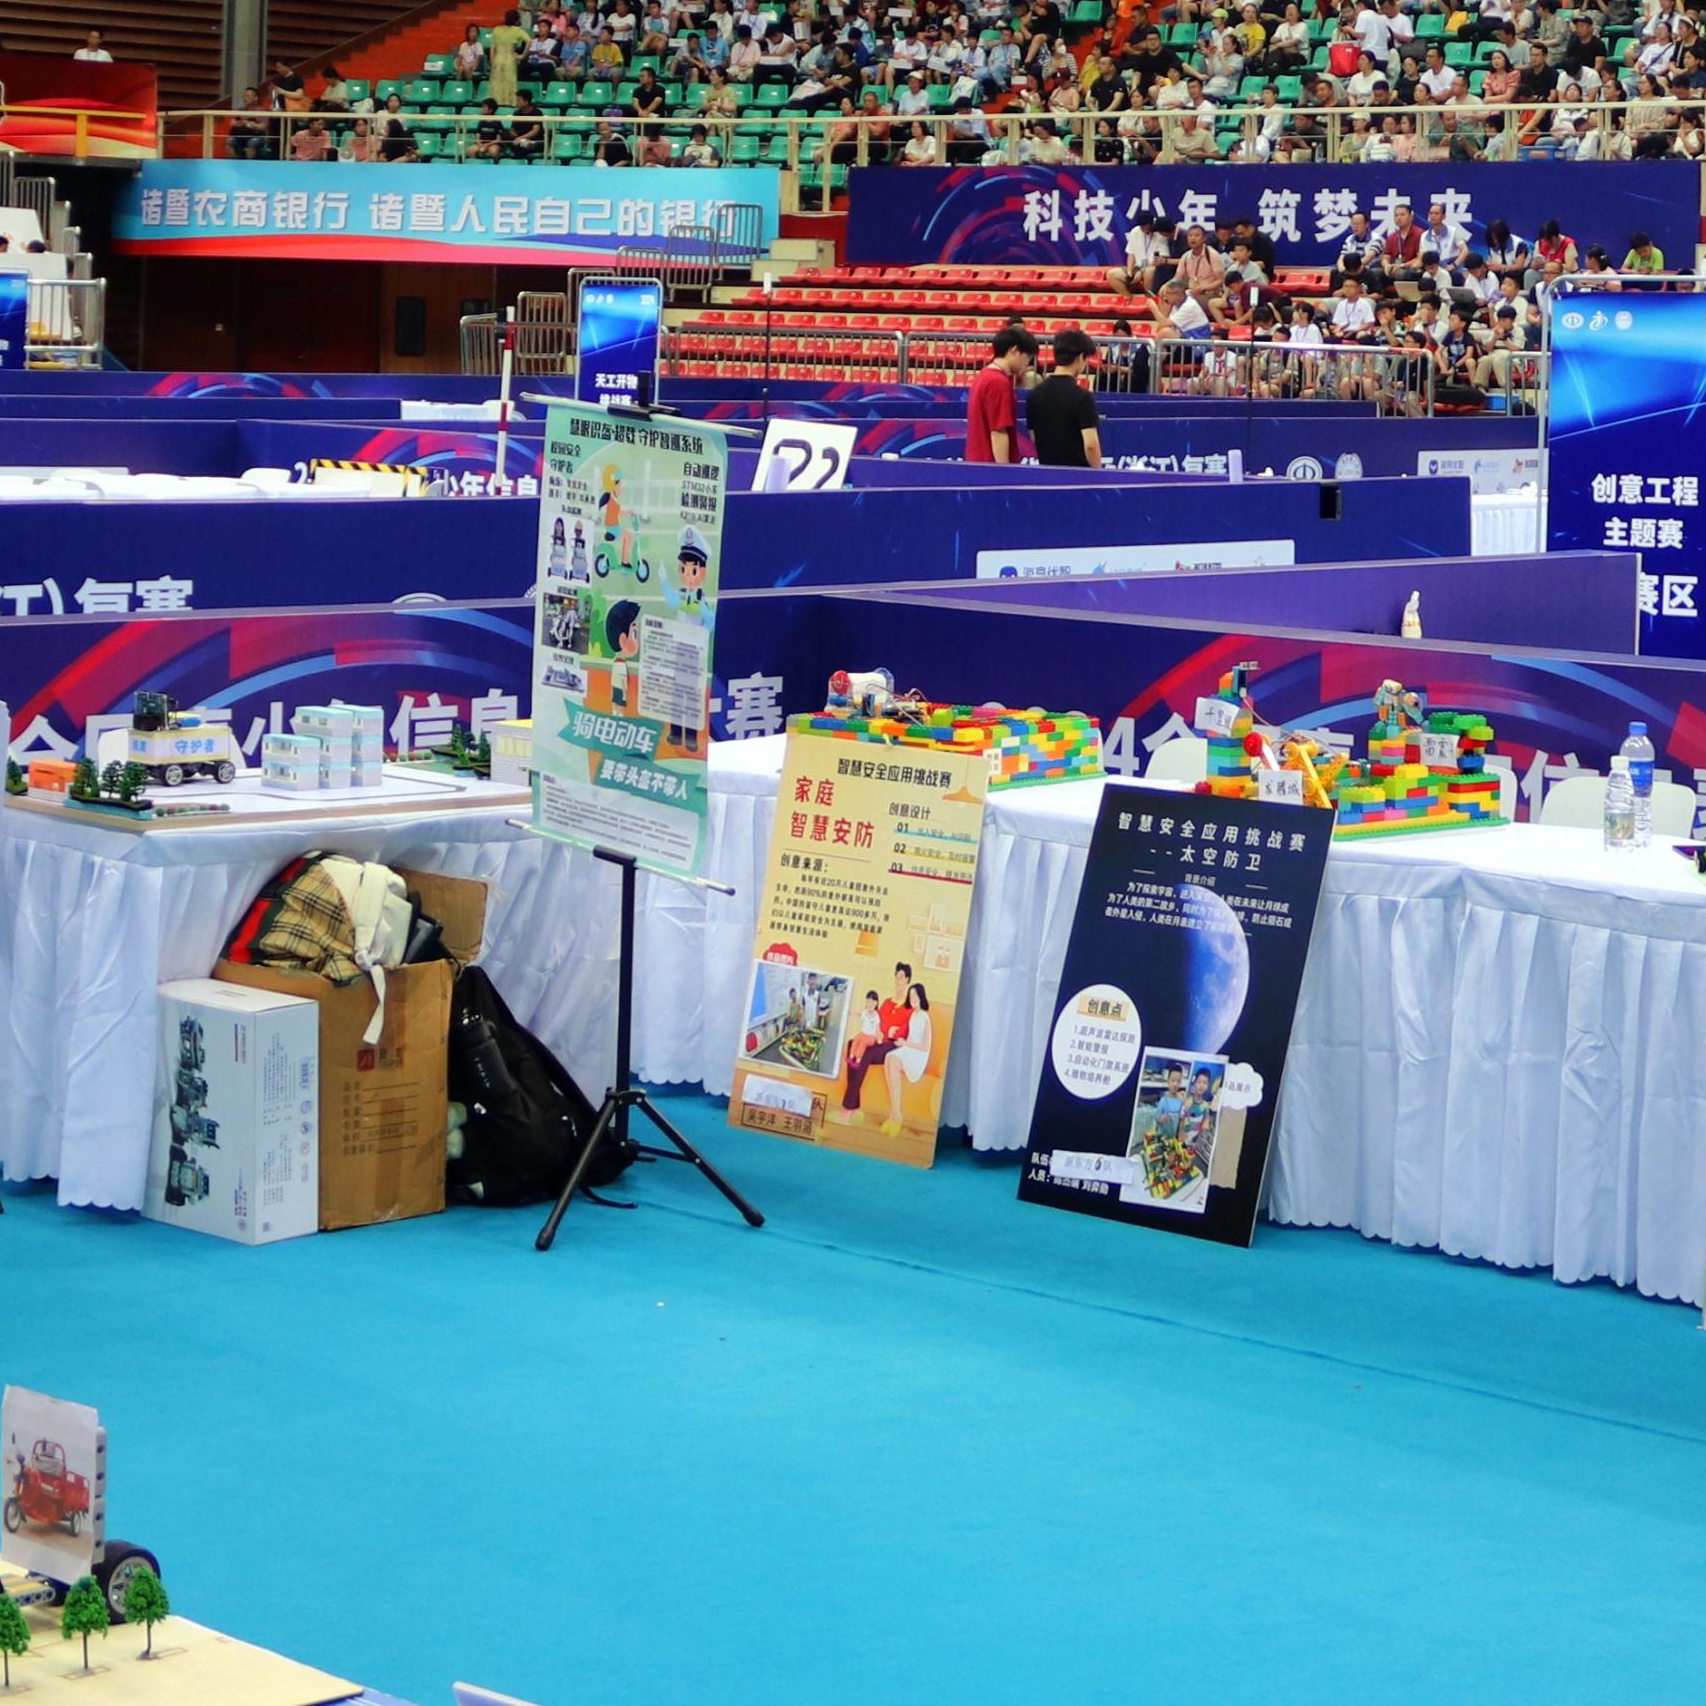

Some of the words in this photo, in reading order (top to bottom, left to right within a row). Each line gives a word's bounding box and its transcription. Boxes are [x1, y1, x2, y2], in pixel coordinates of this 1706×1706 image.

[140, 187, 351, 232] 诸暨农商银行
[368, 190, 737, 240] 诸暨人民自己的银行
[1021, 187, 1219, 244] 科技少年
[1257, 185, 1474, 245] 筑梦未来
[1590, 473, 1699, 507] 创意工程
[1602, 517, 1684, 551] 主题赛
[173, 739, 216, 755] 守护者
[572, 707, 657, 755] 骑电动车
[598, 755, 689, 800] 要带头盔不带人
[837, 756, 953, 791] 智慧安全应用挑战赛
[794, 775, 836, 808] 家庭
[888, 802, 932, 821] 创意设计
[789, 810, 876, 851] 智慧安防
[1117, 811, 1307, 853] 智慧安全应用挑战赛
[1086, 998, 1124, 1017] 创意点
